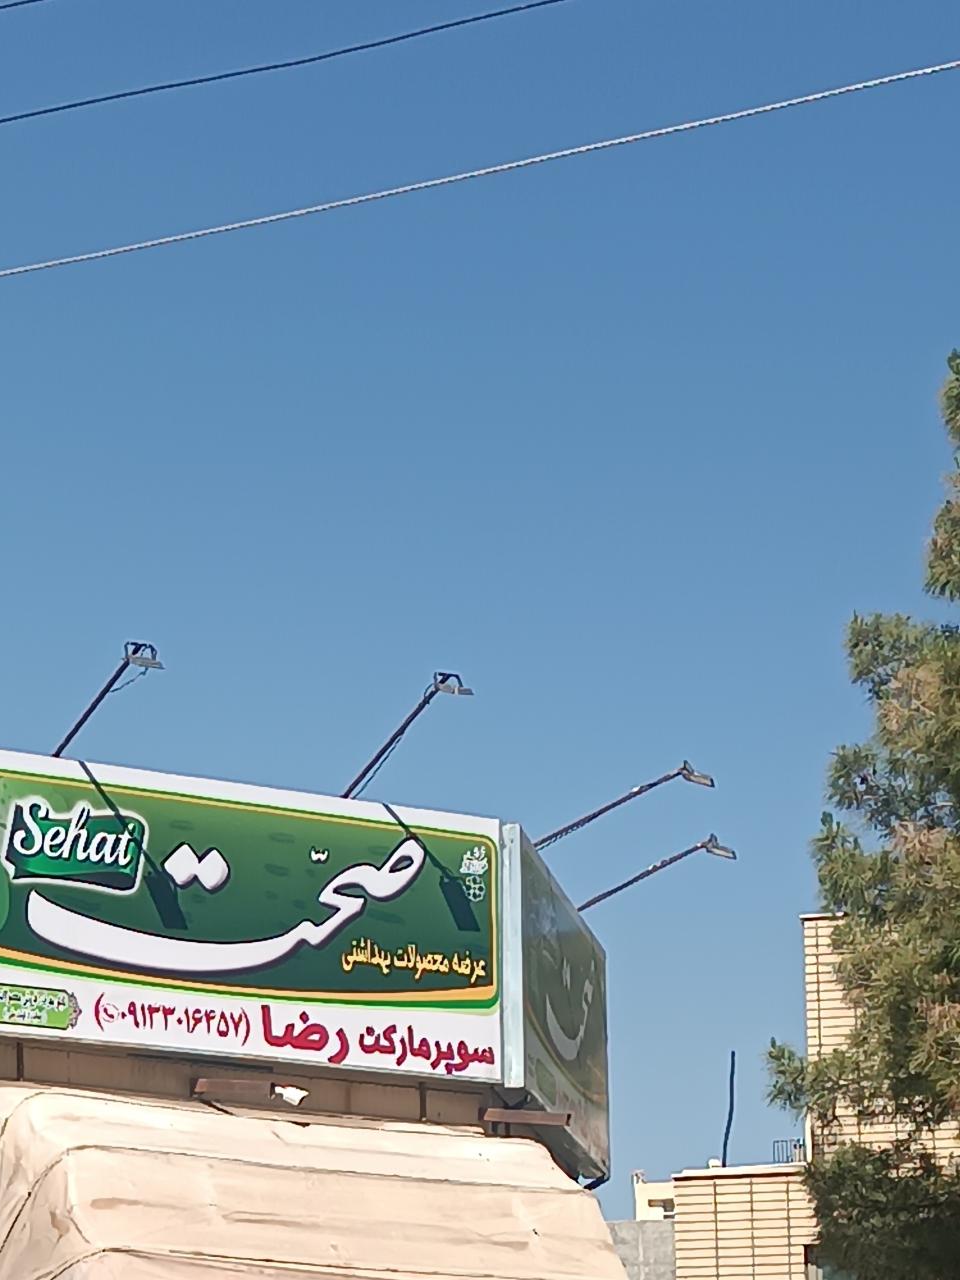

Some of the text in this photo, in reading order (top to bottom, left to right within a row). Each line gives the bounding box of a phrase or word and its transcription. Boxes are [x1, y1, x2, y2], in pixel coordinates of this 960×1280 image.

[13, 799, 134, 866] Sehat
[342, 936, 486, 984] عرضه محصولات بهداشتی
[261, 1004, 350, 1065] رضا
